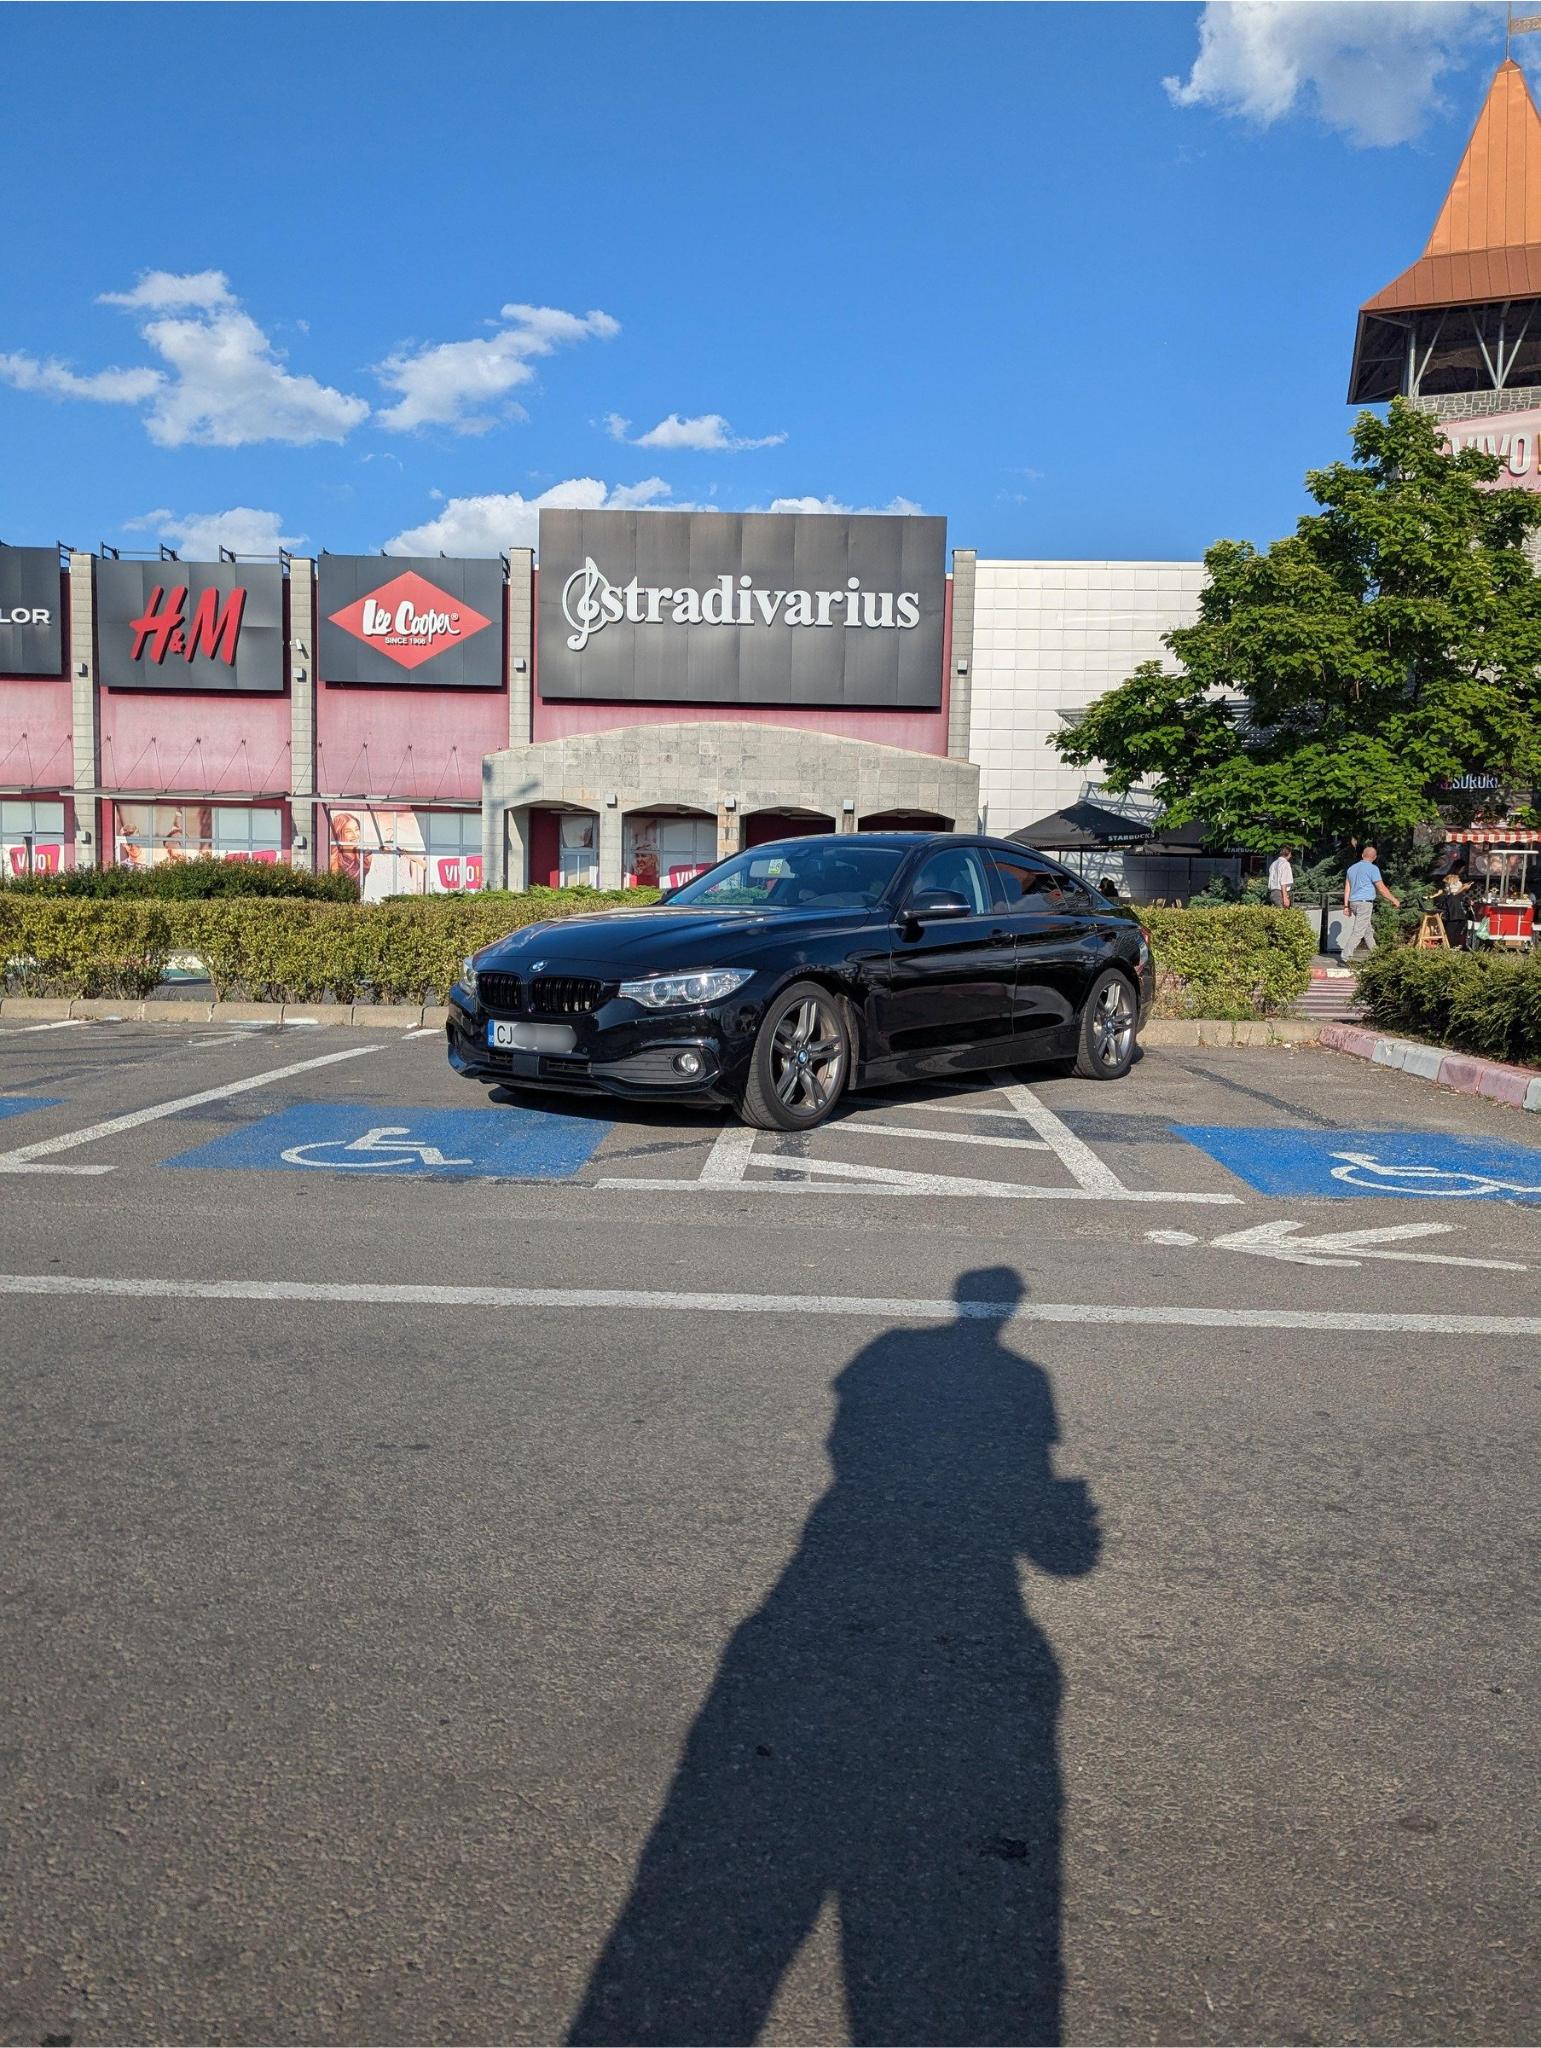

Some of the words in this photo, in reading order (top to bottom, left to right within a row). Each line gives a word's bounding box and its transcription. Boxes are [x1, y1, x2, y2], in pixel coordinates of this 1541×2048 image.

[600, 575, 921, 629] stradivarius
[128, 585, 246, 666] H&M
[362, 598, 393, 636] Lee
[384, 636, 409, 645] SINCE
[1107, 832, 1155, 842] STARBUCKS
[444, 864, 481, 883] VIO!
[496, 1025, 514, 1045] CJ
